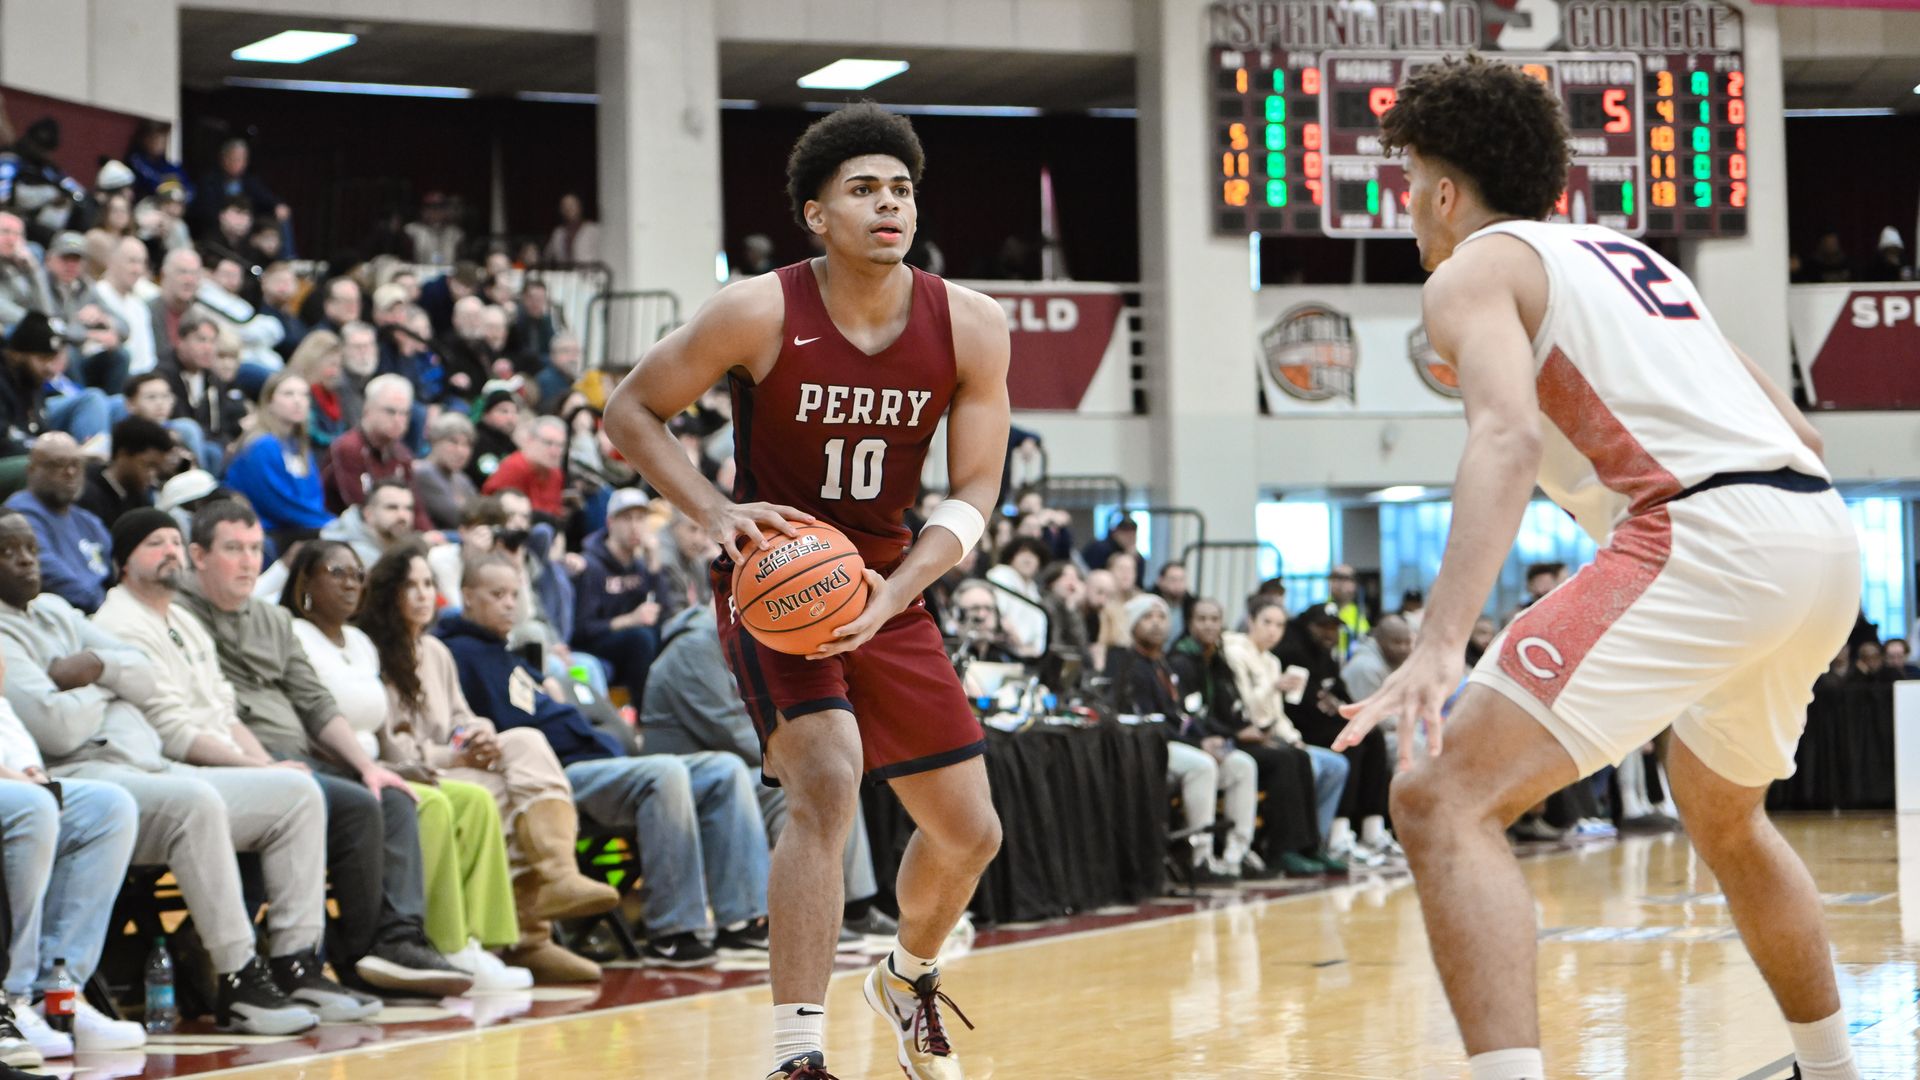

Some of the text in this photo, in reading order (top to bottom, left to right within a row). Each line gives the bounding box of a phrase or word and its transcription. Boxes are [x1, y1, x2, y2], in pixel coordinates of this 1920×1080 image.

[1226, 1, 1480, 50] SPRINGFIELD
[1566, 2, 1742, 51] COLLEGE
[1236, 67, 1248, 94] 1
[1273, 68, 1285, 94] 1
[1335, 60, 1393, 82] HOME
[1561, 60, 1635, 85] VISITOR
[1657, 71, 1673, 96] 3
[1728, 71, 1744, 96] 2
[1603, 89, 1631, 133] 5
[1656, 99, 1745, 124] 4 1 0
[1229, 123, 1249, 150] 5
[1651, 126, 1746, 152] 10 0 1
[1223, 151, 1249, 178] 11
[1651, 154, 1747, 180] 11 0 0
[1366, 179, 1379, 215] 1
[1621, 180, 1633, 215] 1
[1729, 181, 1746, 208] 2
[1572, 239, 1700, 320] 12
[796, 383, 932, 427] PERRY
[820, 438, 888, 500] 10
[755, 539, 831, 583] PRECISION
[765, 562, 851, 621] SPALDING
[1516, 636, 1565, 679] C
